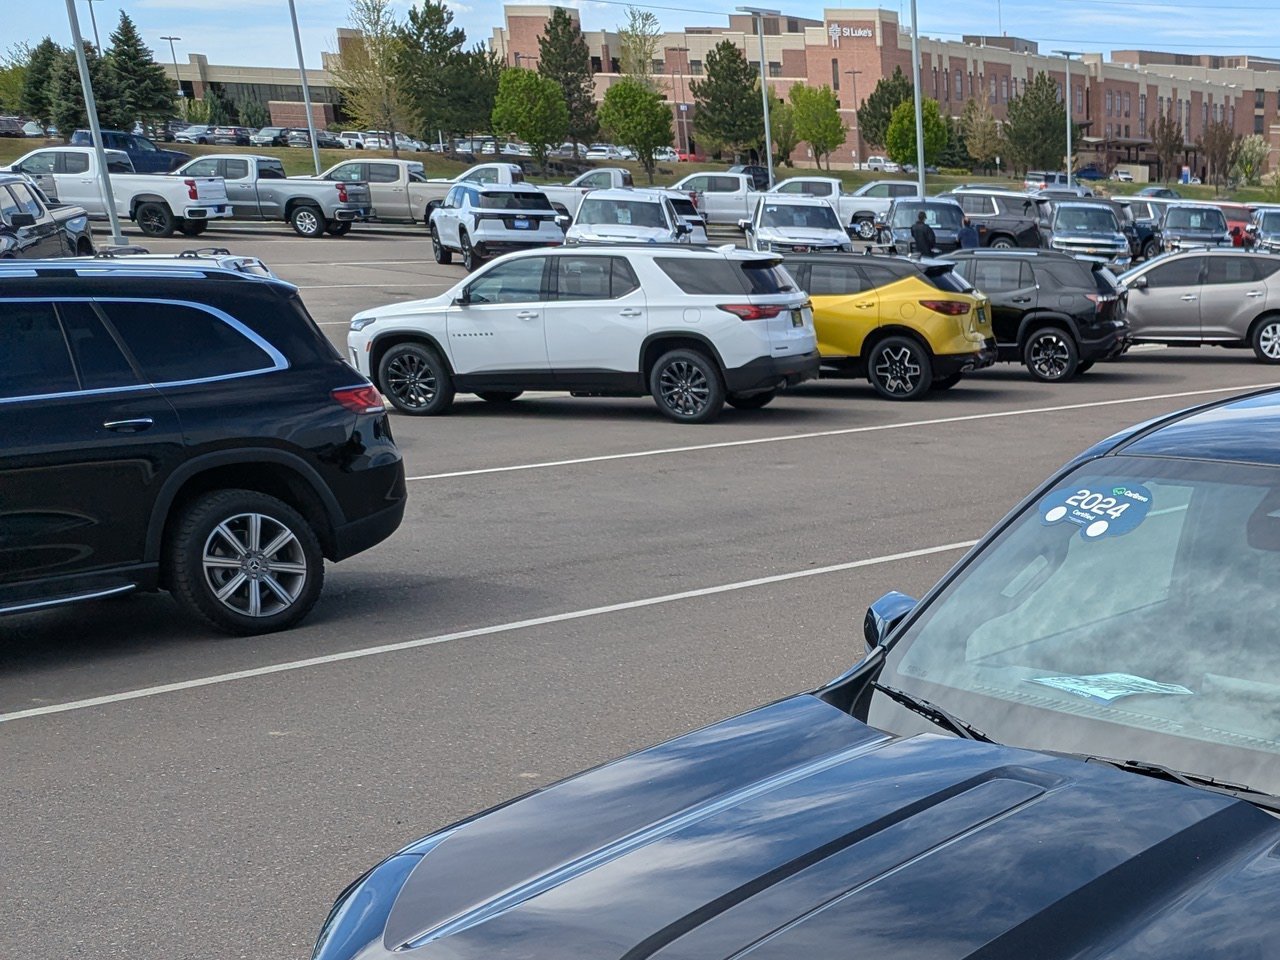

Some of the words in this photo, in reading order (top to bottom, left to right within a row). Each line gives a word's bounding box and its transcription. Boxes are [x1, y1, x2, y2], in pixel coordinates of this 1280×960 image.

[842, 28, 850, 37] St
[851, 28, 872, 37] Luke's
[1065, 489, 1131, 519] 2024
